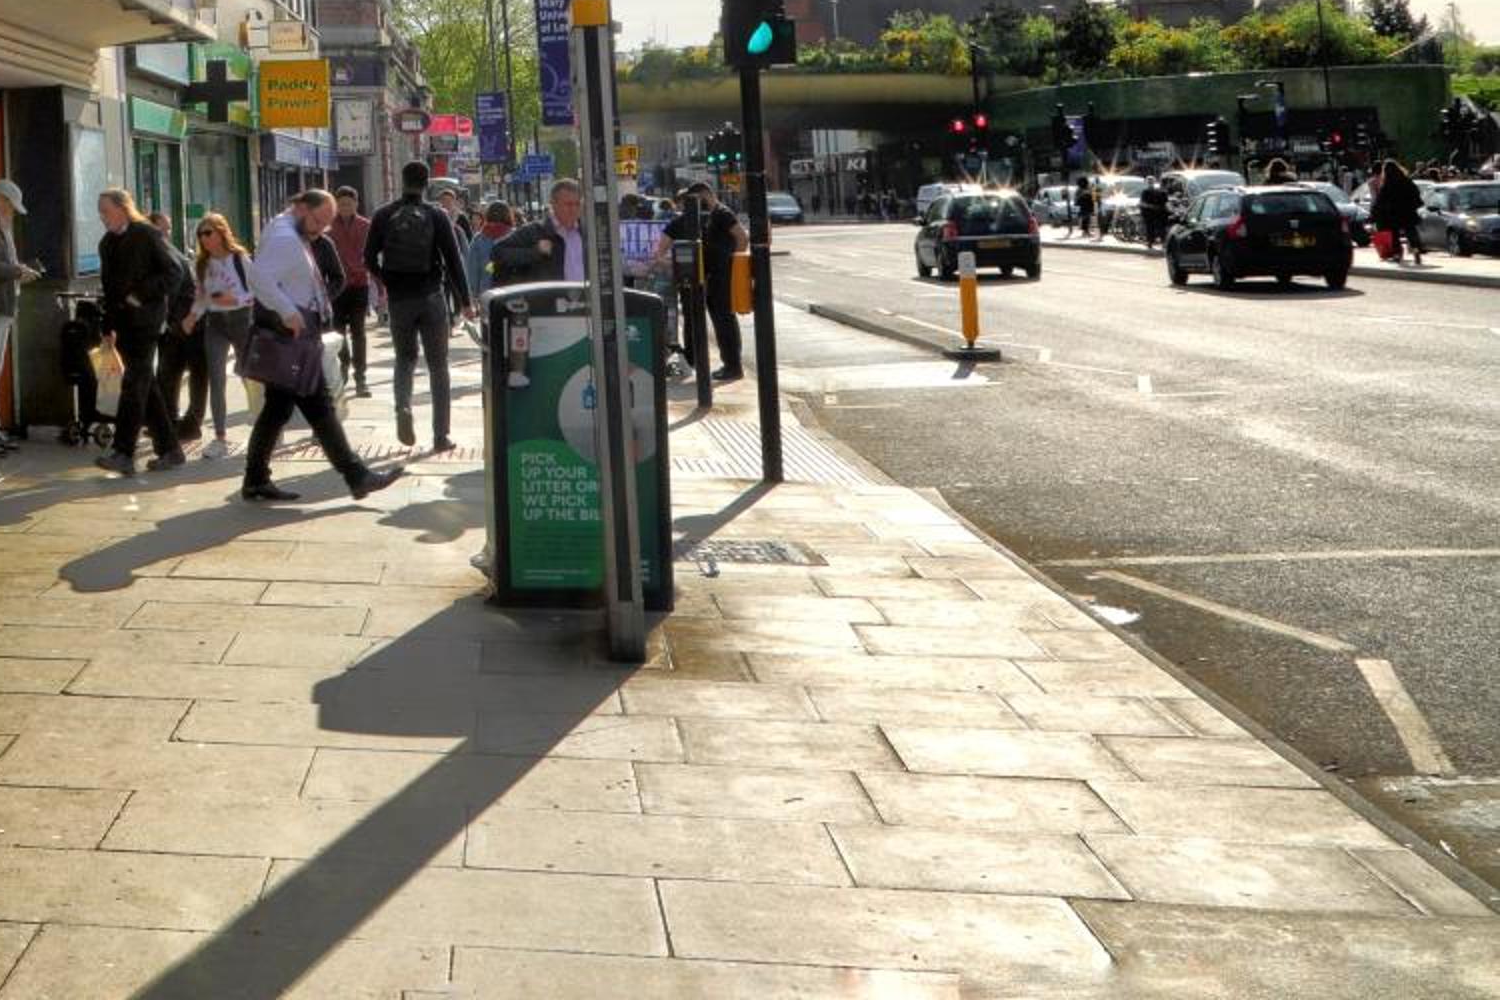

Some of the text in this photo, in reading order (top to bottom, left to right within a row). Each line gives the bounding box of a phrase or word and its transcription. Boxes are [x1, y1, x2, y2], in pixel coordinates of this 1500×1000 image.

[267, 78, 317, 93] Paddy
[267, 96, 318, 109] Power
[520, 452, 557, 466] PICK
[521, 466, 588, 479] UP YOUR
[521, 480, 598, 493] LITTER OR
[522, 494, 587, 507] WE PICK
[523, 508, 604, 521] UP THE BIL
